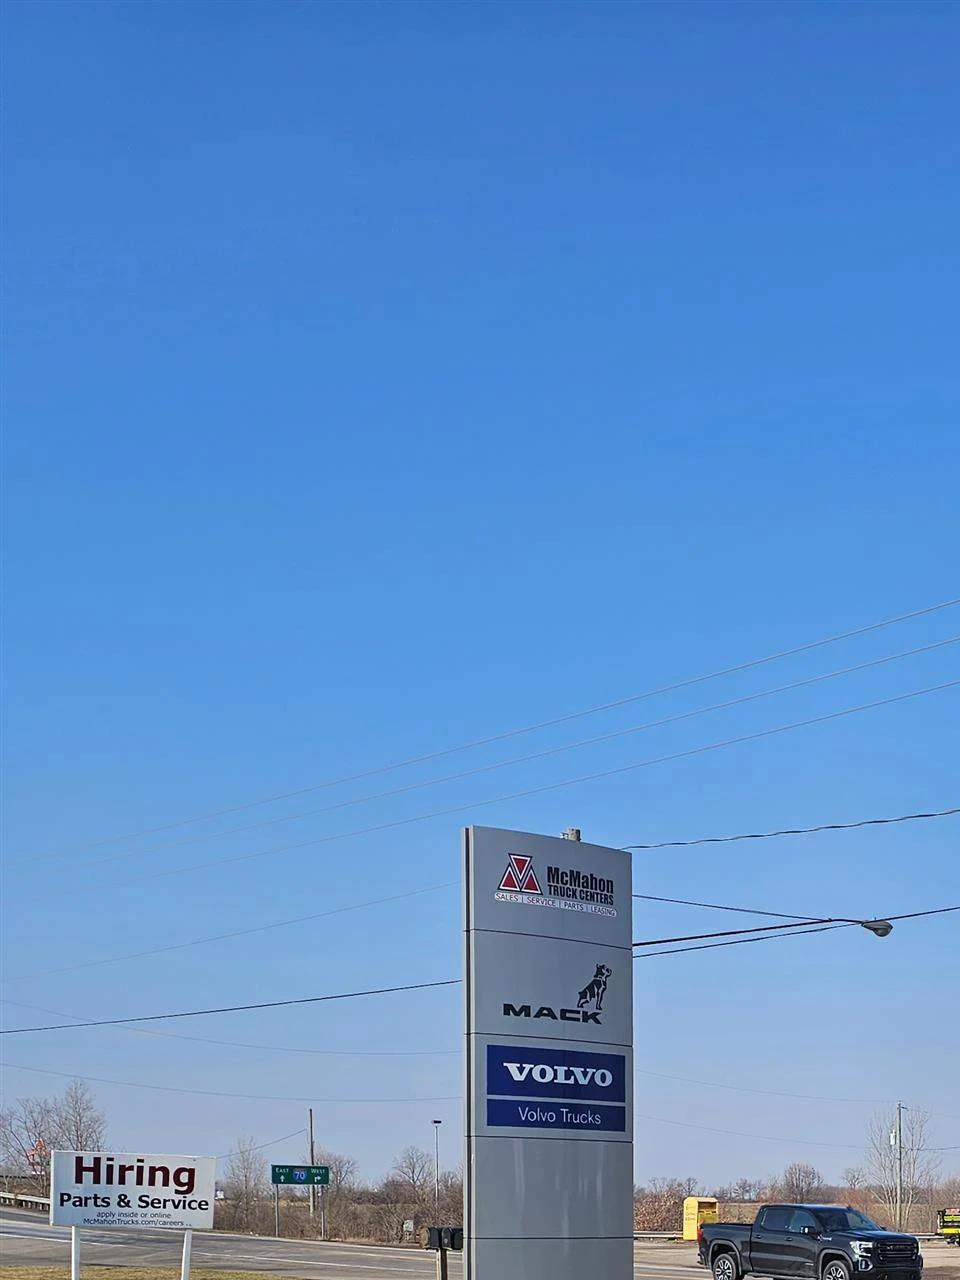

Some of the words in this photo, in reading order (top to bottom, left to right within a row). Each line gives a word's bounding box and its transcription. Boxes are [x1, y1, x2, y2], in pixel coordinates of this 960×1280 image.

[547, 866, 614, 894] McMahon
[495, 892, 519, 901] SALES
[526, 896, 556, 907] SERVICE
[564, 901, 584, 910] PARTS
[591, 905, 616, 917] LEASING
[547, 884, 578, 899] TRUCK
[580, 889, 614, 906] CENTERS
[503, 1003, 602, 1024] MACK
[503, 1062, 613, 1087] VOLVO
[518, 1106, 556, 1123] Volvo
[560, 1108, 601, 1124] Trucks
[74, 1156, 196, 1195] Hiring
[293, 1171, 306, 1180] 70
[59, 1192, 111, 1208] Parts
[117, 1193, 132, 1209] &
[137, 1194, 209, 1211] Service
[96, 1211, 116, 1219] apply
